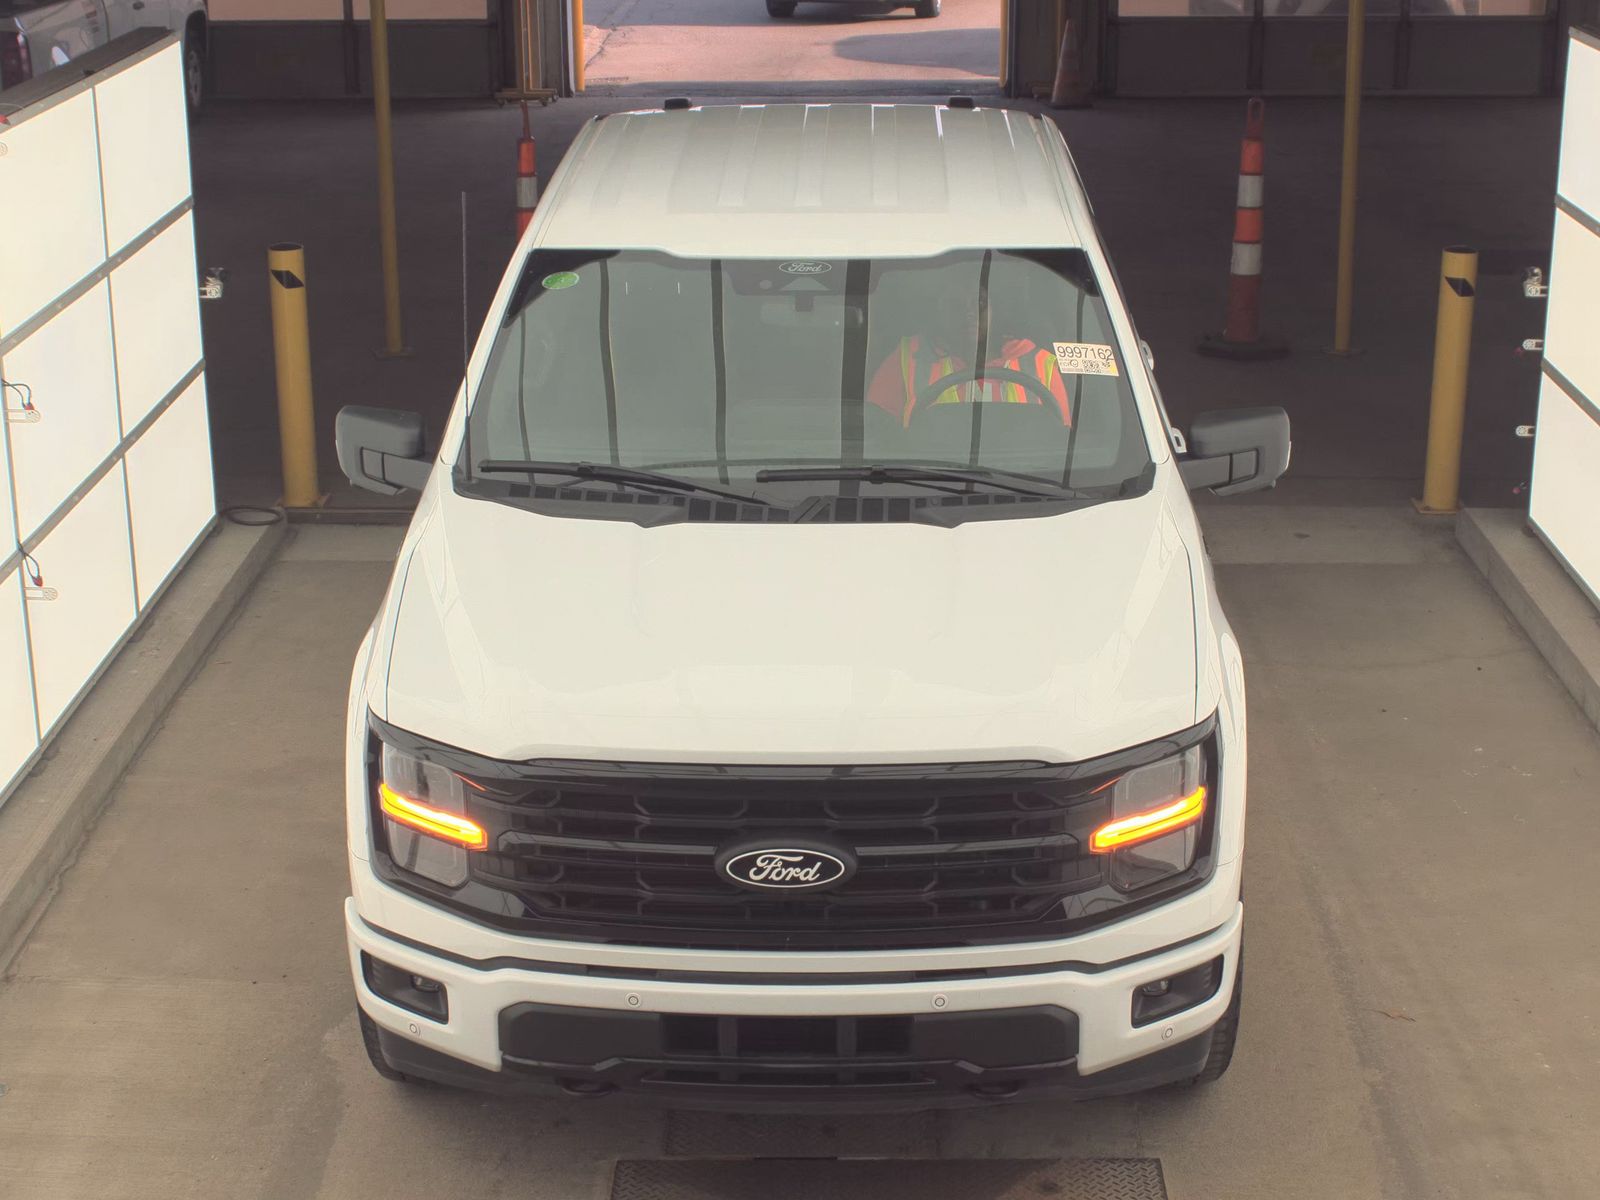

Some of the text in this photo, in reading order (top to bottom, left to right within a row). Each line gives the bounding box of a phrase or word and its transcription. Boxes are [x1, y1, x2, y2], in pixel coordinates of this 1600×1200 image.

[788, 262, 823, 272] Ford
[1056, 345, 1115, 361] 9997162
[749, 854, 822, 881] Ford
